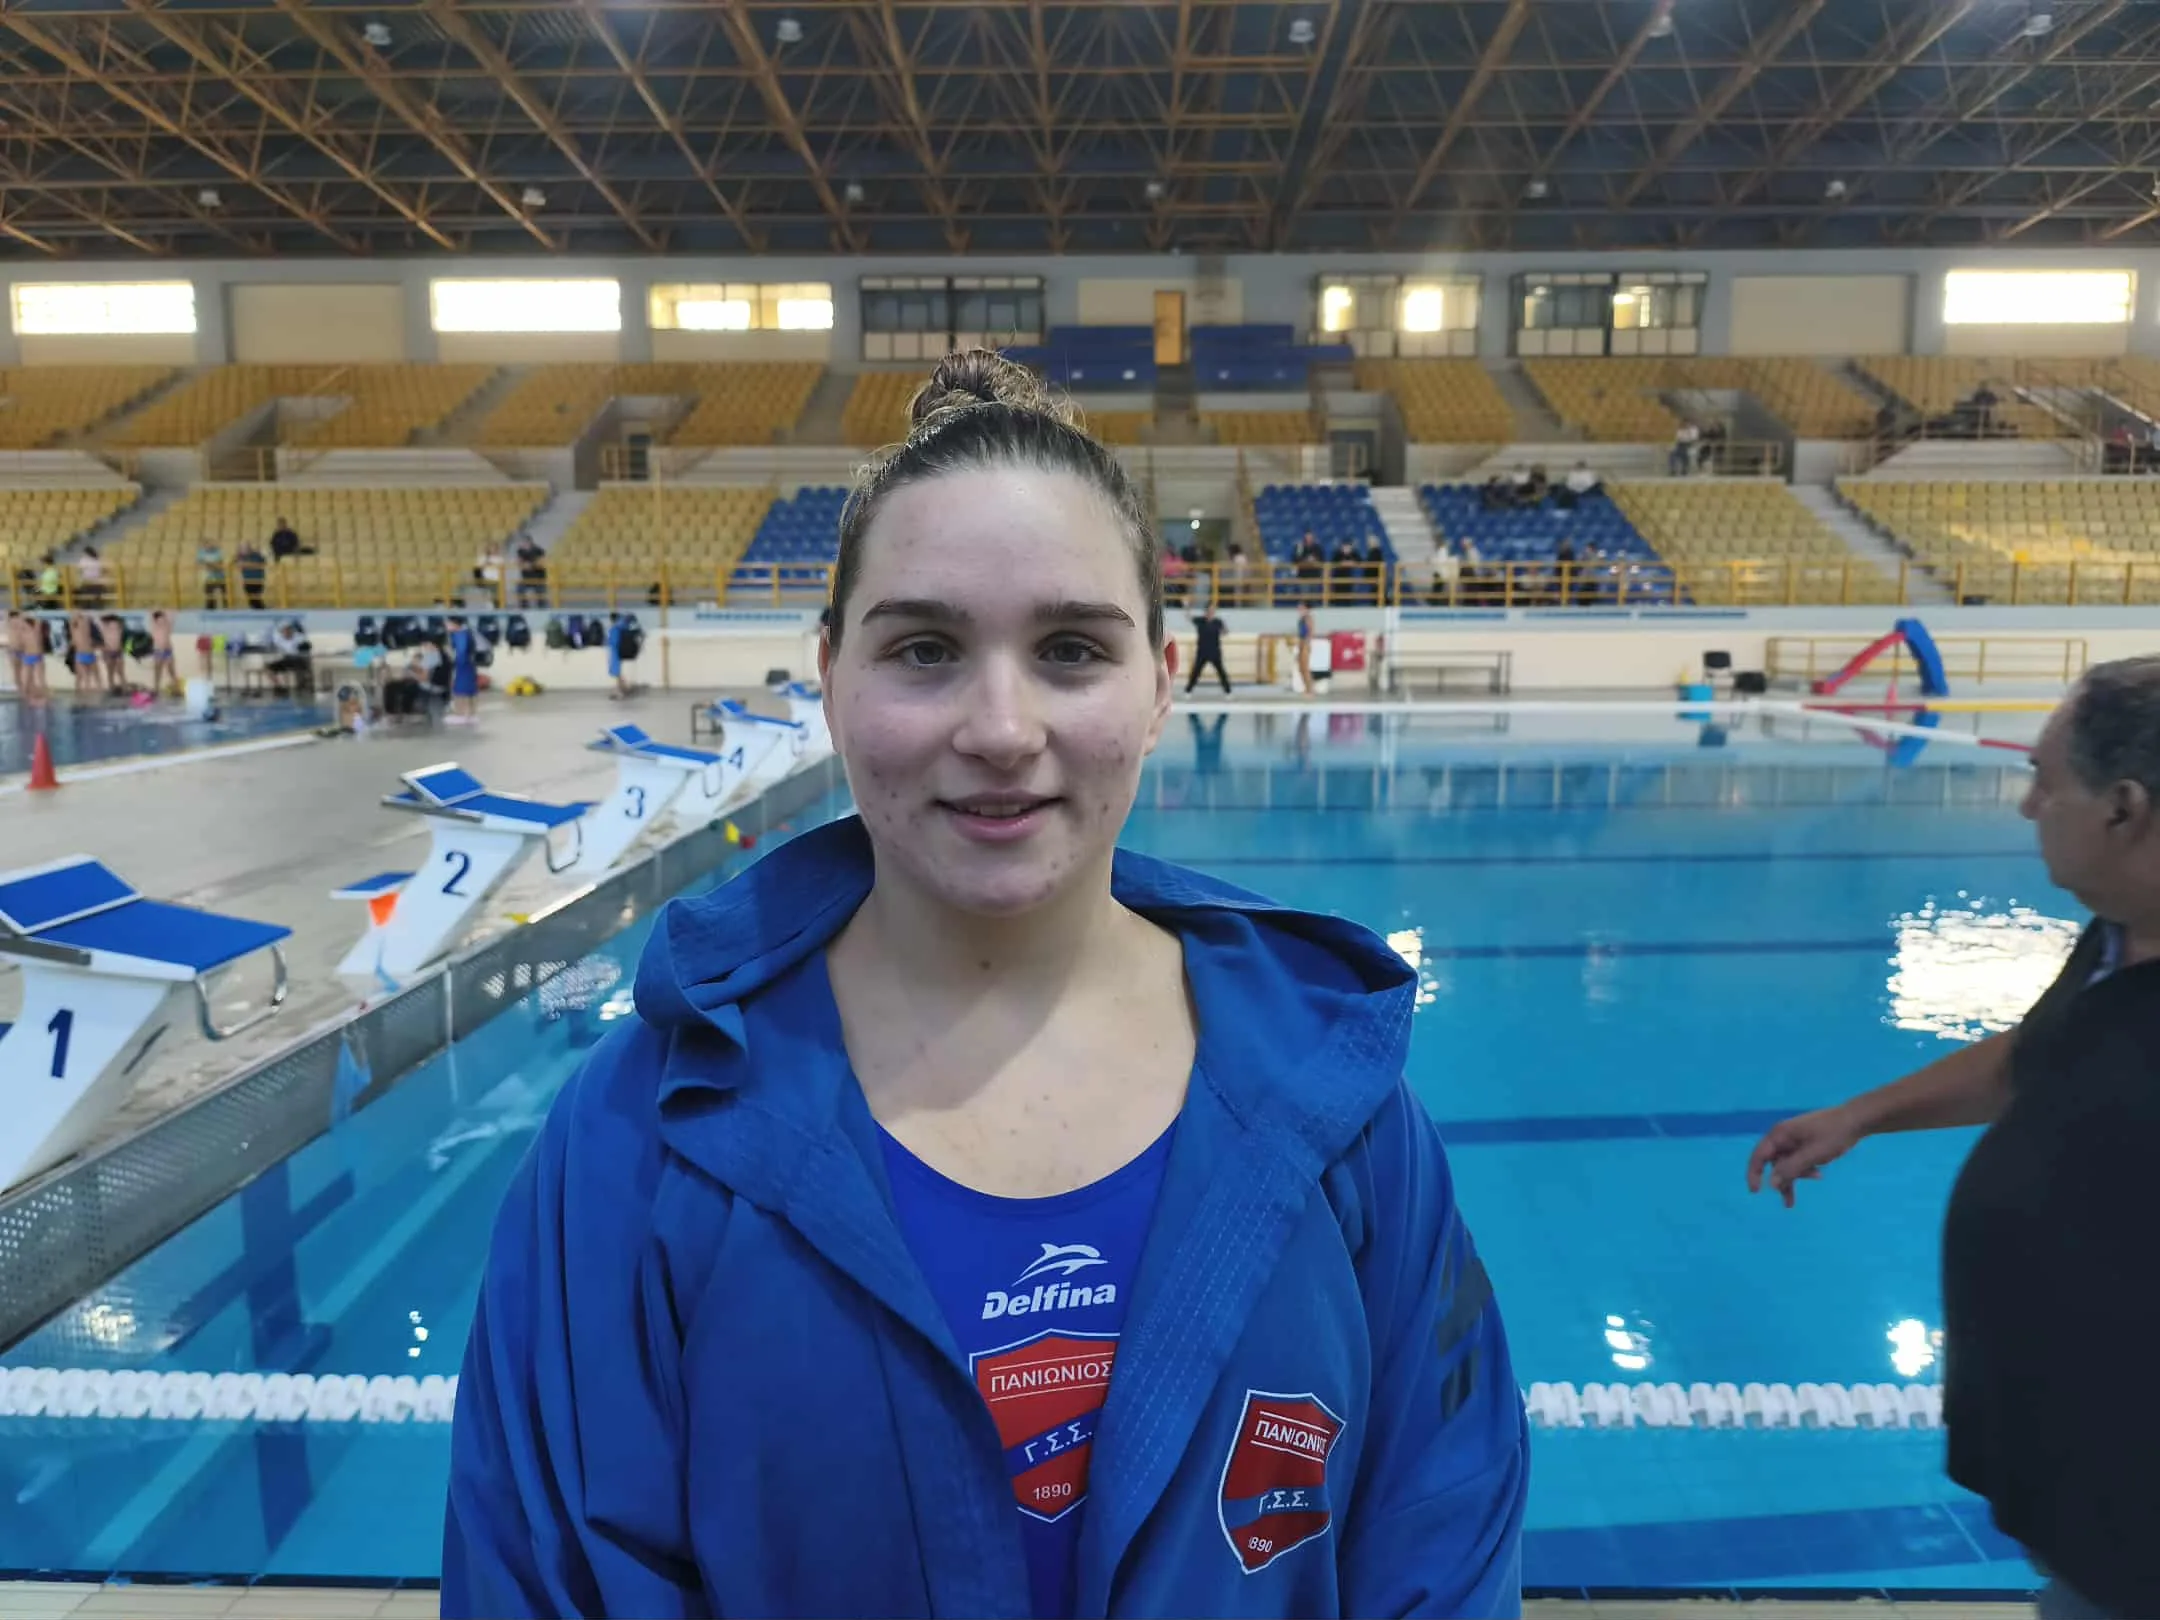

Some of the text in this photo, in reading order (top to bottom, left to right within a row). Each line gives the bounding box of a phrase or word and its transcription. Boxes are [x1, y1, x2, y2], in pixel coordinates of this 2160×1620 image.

[728, 747, 744, 770] 4
[624, 786, 645, 819] 3
[442, 850, 471, 897] 2
[47, 1009, 73, 1079] 1
[981, 1282, 1117, 1320] Delfina
[990, 1360, 1113, 1393] ΠΑΝΙΩΝΙΟΣ
[1024, 1421, 1093, 1463] Γ.Σ.Σ.
[1033, 1482, 1072, 1501] 1890
[1247, 1536, 1273, 1553] 890
